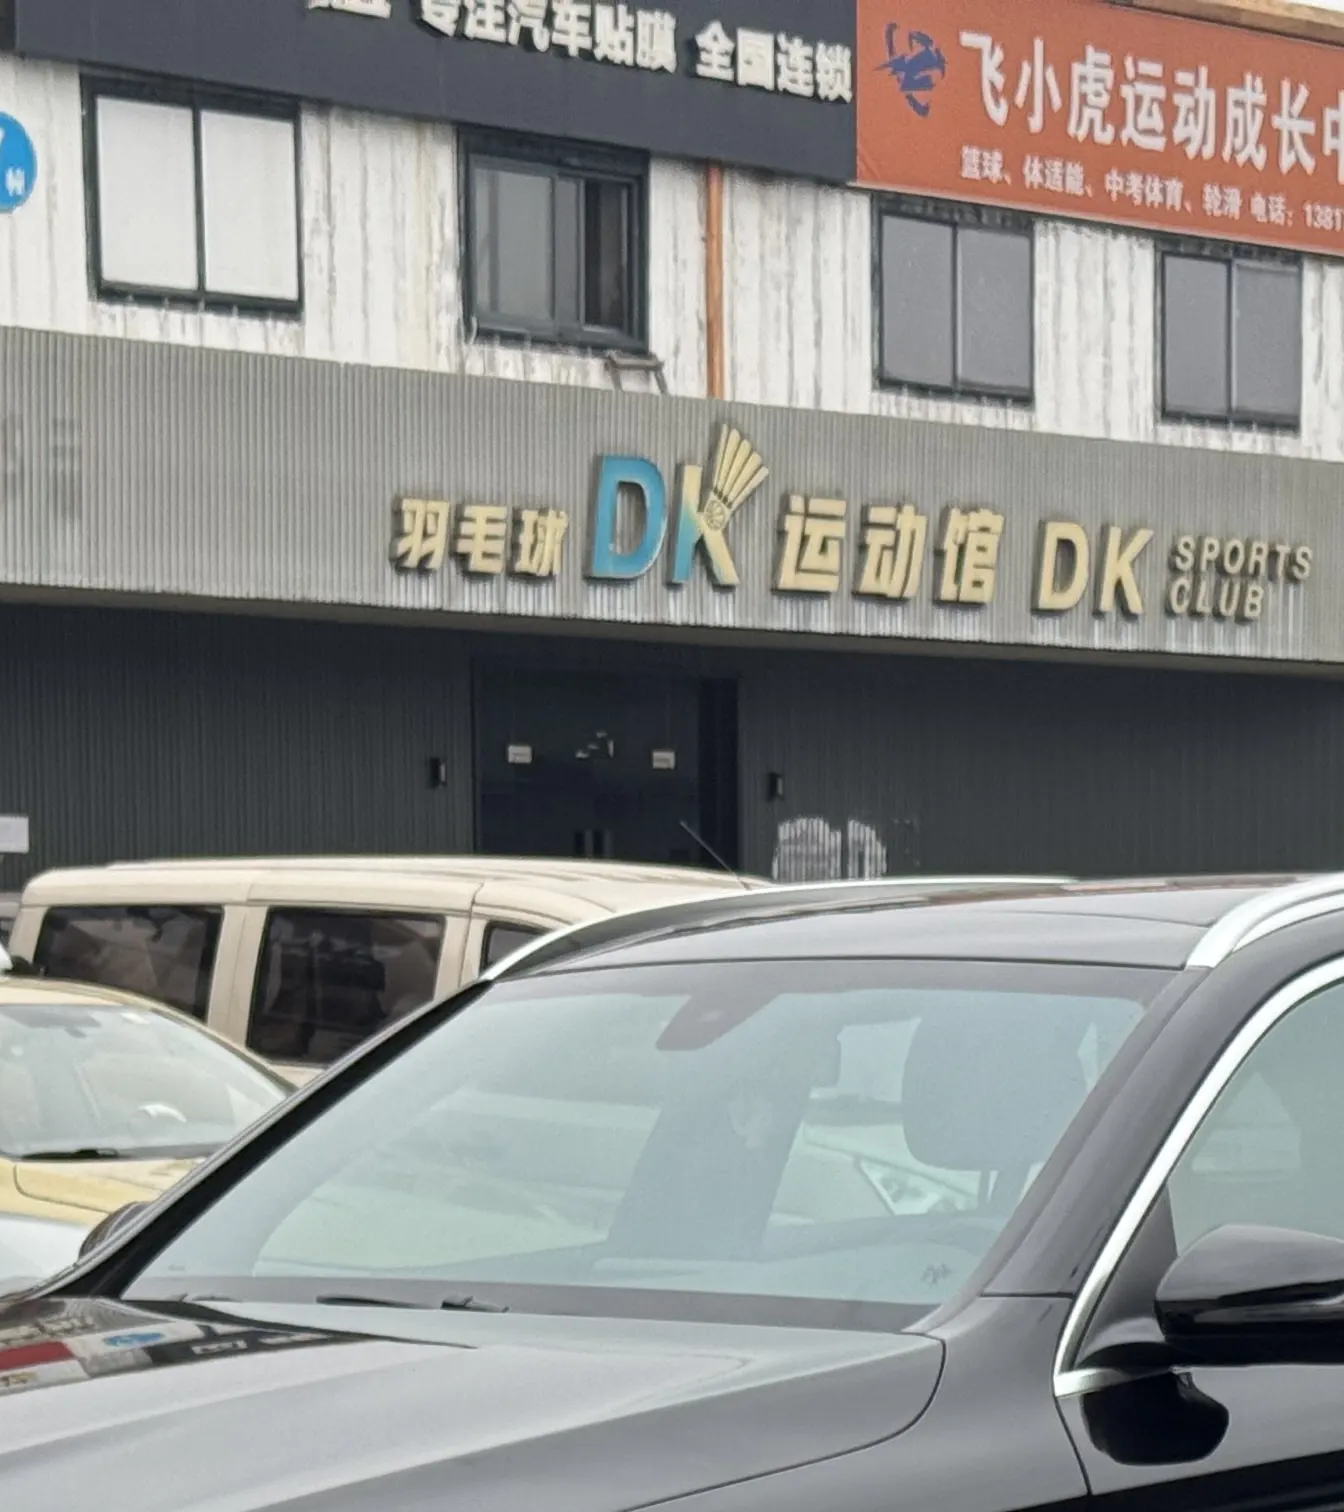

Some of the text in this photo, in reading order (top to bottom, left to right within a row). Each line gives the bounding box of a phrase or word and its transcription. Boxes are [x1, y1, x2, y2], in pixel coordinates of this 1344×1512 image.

[696, 20, 852, 103] 全国连锁
[394, 438, 1155, 615] 羽毛球 DK 运动馆 DK
[1172, 534, 1314, 580] SPORTS
[1169, 579, 1265, 620] CLUB
